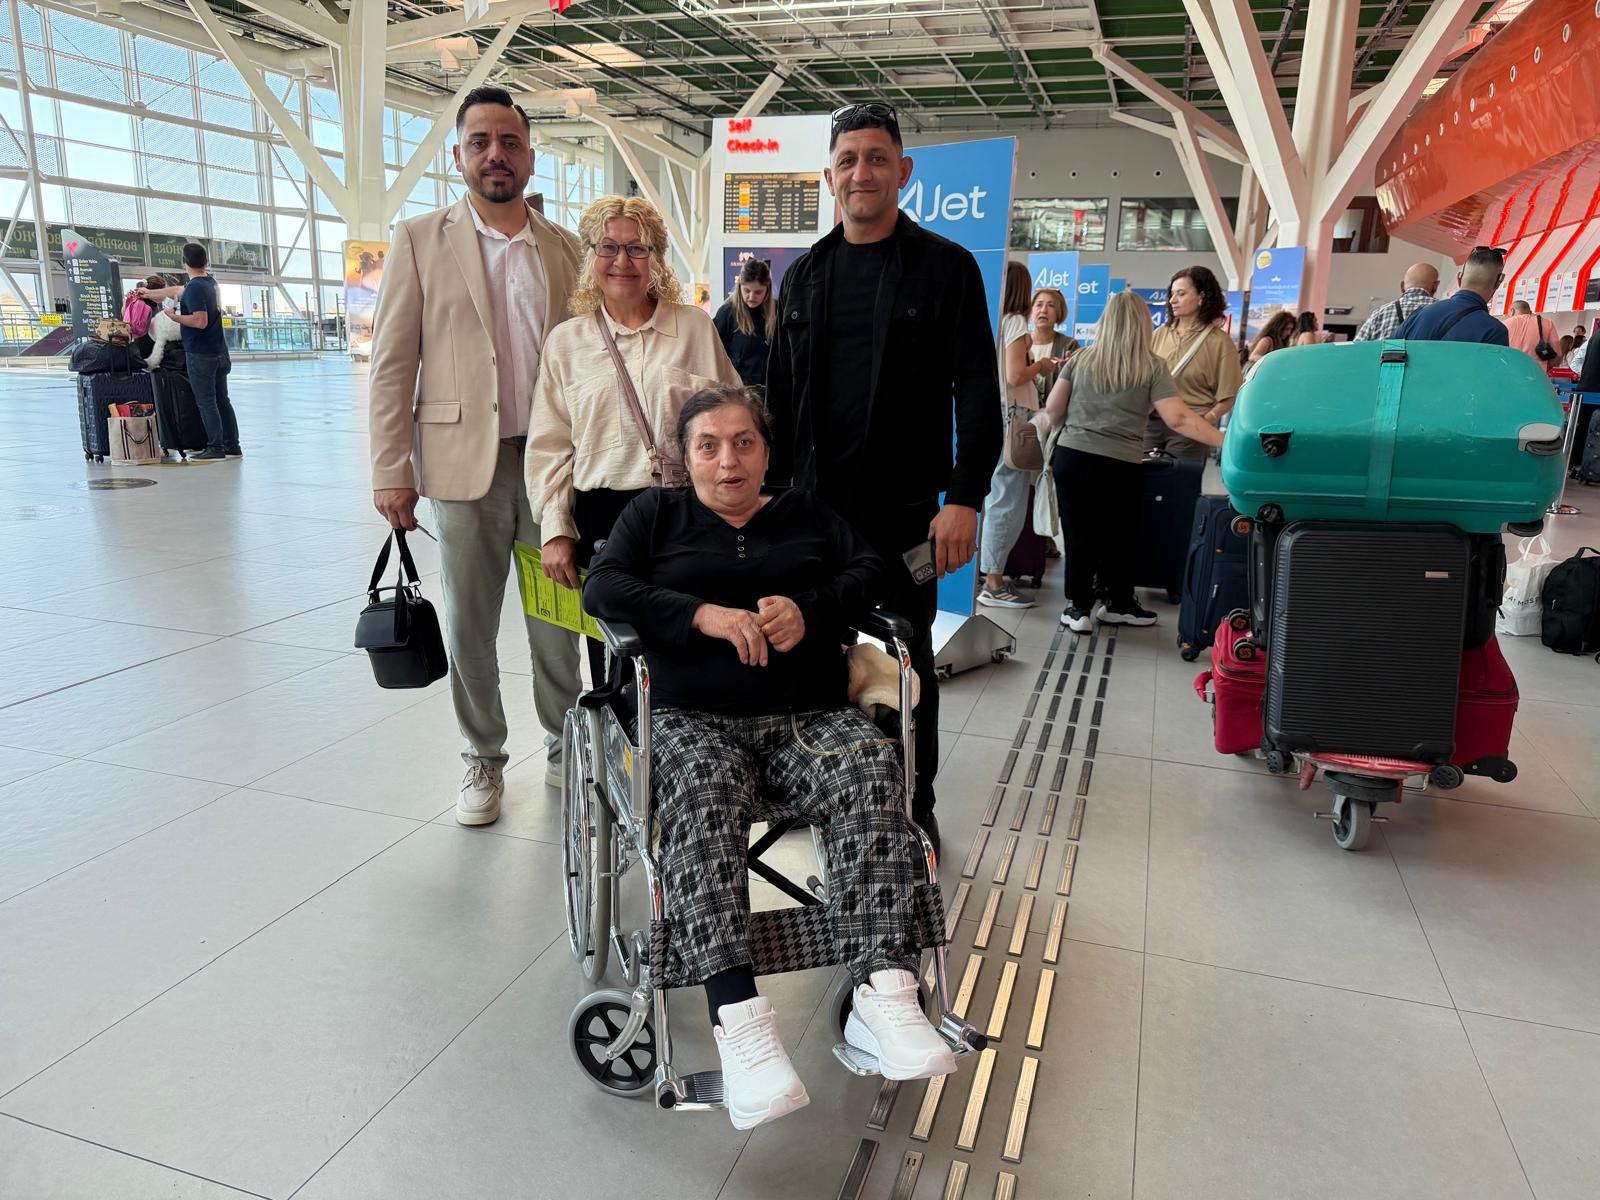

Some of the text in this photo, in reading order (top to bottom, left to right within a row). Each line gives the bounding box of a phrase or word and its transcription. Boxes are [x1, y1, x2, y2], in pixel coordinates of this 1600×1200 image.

[728, 118, 753, 133] Self
[727, 138, 780, 153] Check-in
[898, 179, 987, 222] AJet
[1034, 267, 1070, 287] AJet
[1078, 280, 1099, 294] et
